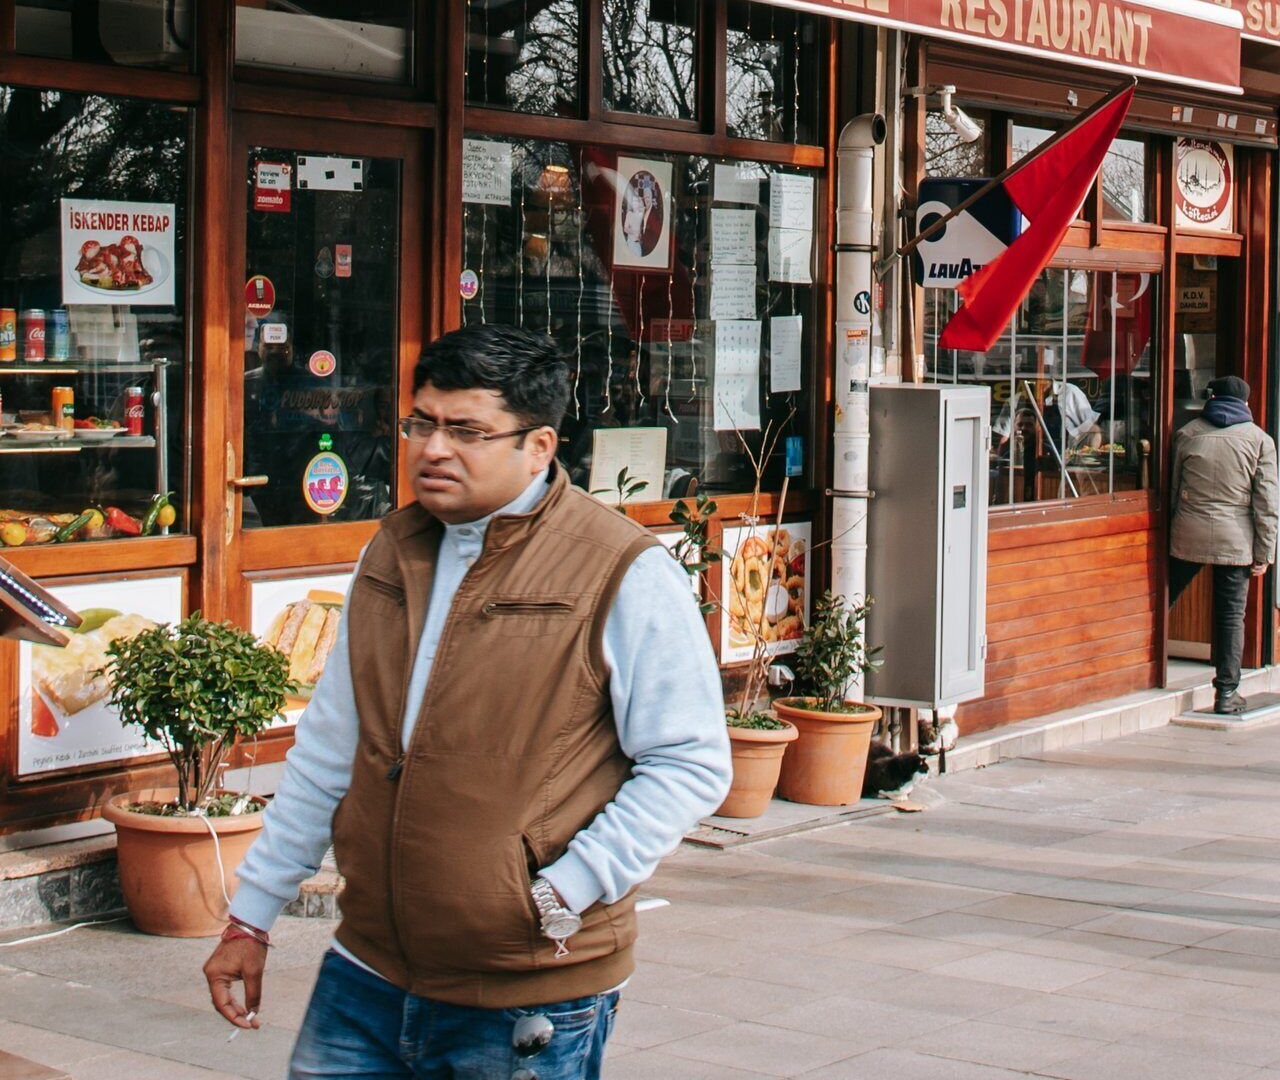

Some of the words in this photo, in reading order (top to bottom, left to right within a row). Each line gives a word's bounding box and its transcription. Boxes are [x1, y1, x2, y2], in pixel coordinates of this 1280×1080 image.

[257, 195, 283, 205] zomato
[69, 206, 130, 232] İSKENDER
[132, 214, 170, 233] KEBAP
[928, 257, 988, 279] LAVA
